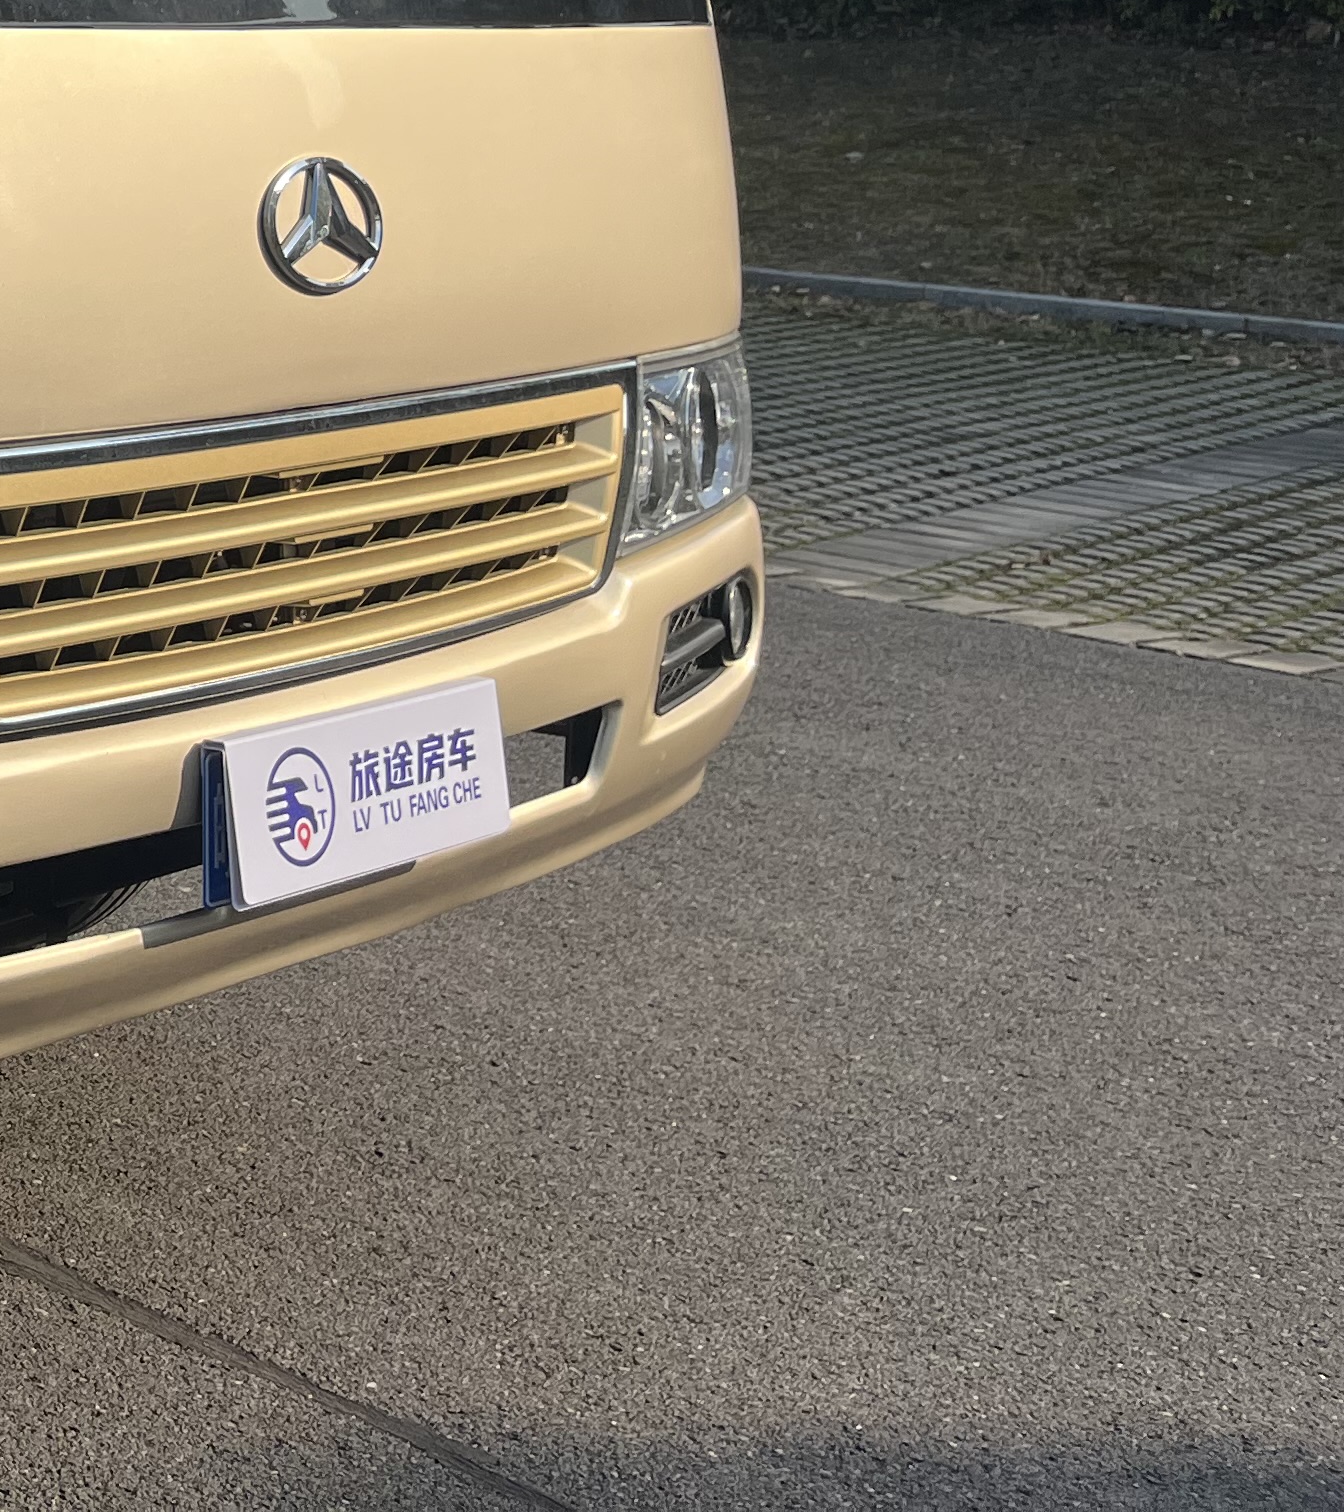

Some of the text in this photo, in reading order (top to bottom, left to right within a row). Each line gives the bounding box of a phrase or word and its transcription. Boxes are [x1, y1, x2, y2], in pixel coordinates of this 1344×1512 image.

[349, 727, 477, 803] 旅途房车
[353, 776, 482, 833] LV TU FANG CHE
